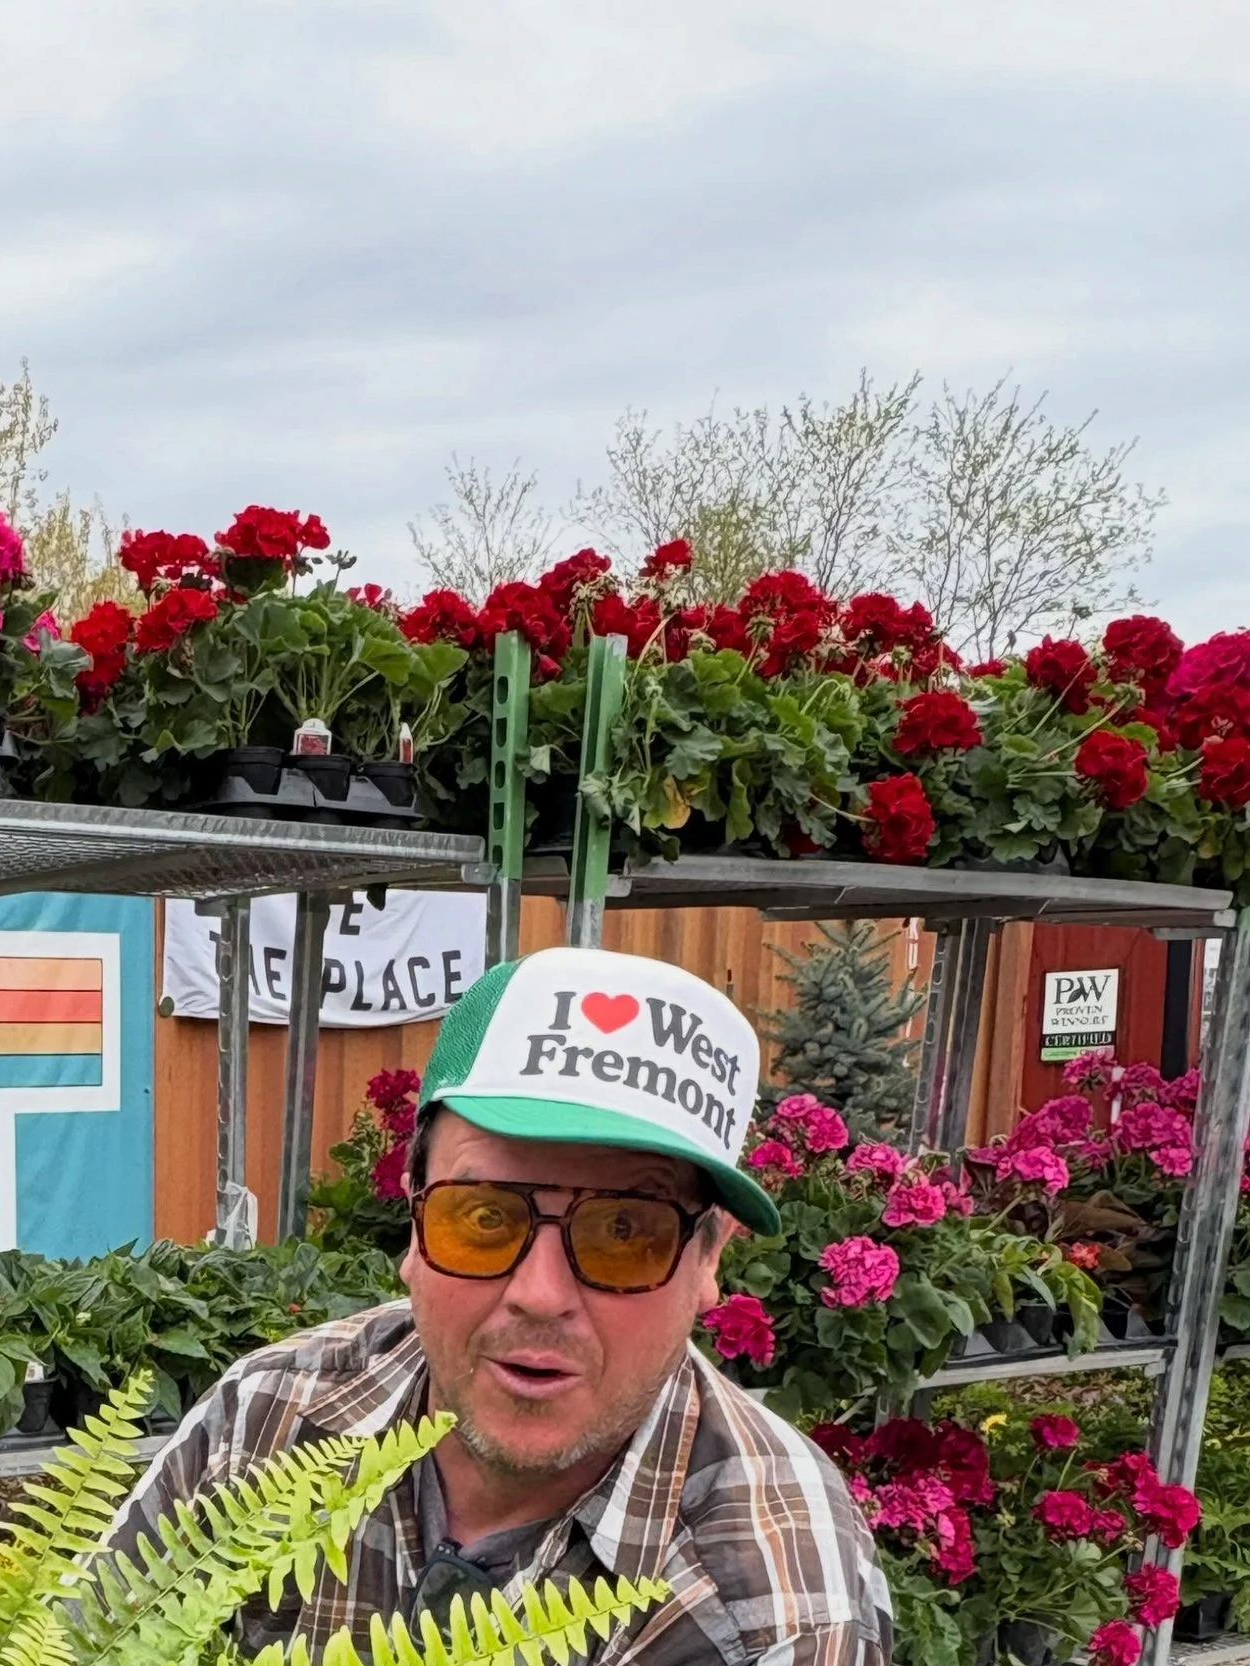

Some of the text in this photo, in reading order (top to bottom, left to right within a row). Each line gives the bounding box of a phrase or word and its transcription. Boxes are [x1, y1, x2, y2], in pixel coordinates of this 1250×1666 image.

[320, 950, 463, 1011] PLACE
[519, 1034, 737, 1150] Fremont
[548, 991, 741, 1096] I West
